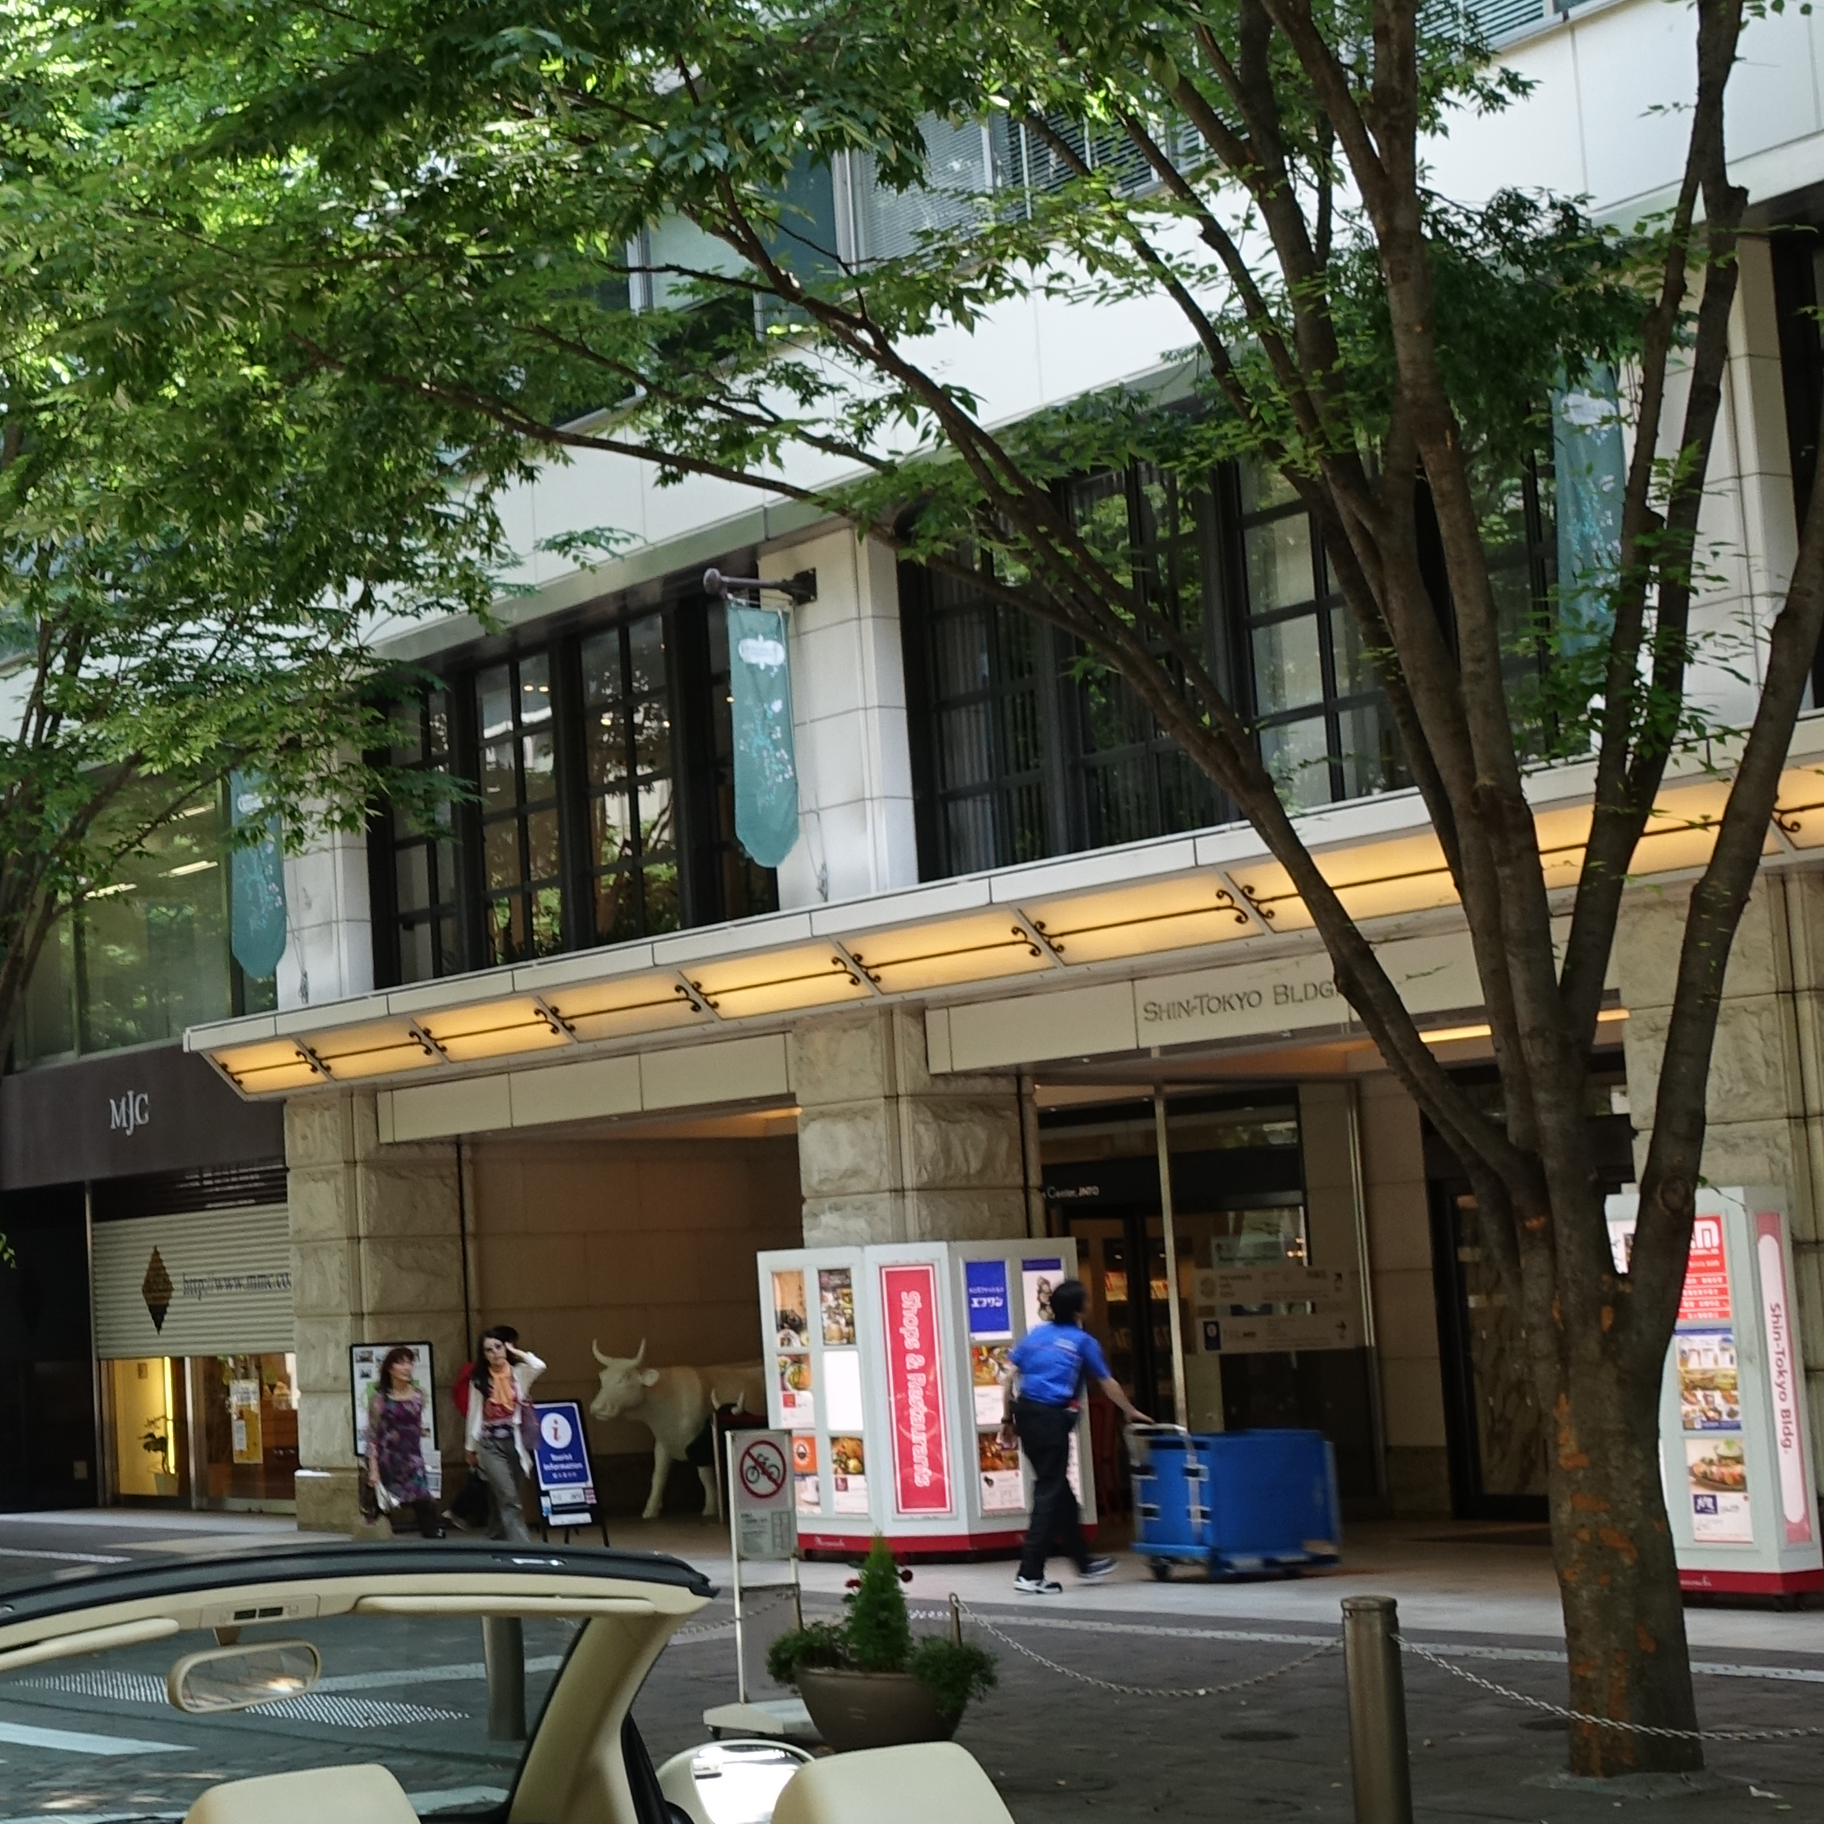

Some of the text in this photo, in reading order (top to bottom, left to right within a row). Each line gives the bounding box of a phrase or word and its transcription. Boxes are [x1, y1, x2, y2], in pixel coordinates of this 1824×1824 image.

[1143, 990, 1262, 1022] SHIN-TOKYO
[110, 1090, 150, 1136] MJC
[899, 1290, 931, 1488] Shops & Restaurants
[1770, 1302, 1796, 1454] Shin-Tokyo Bldg.
